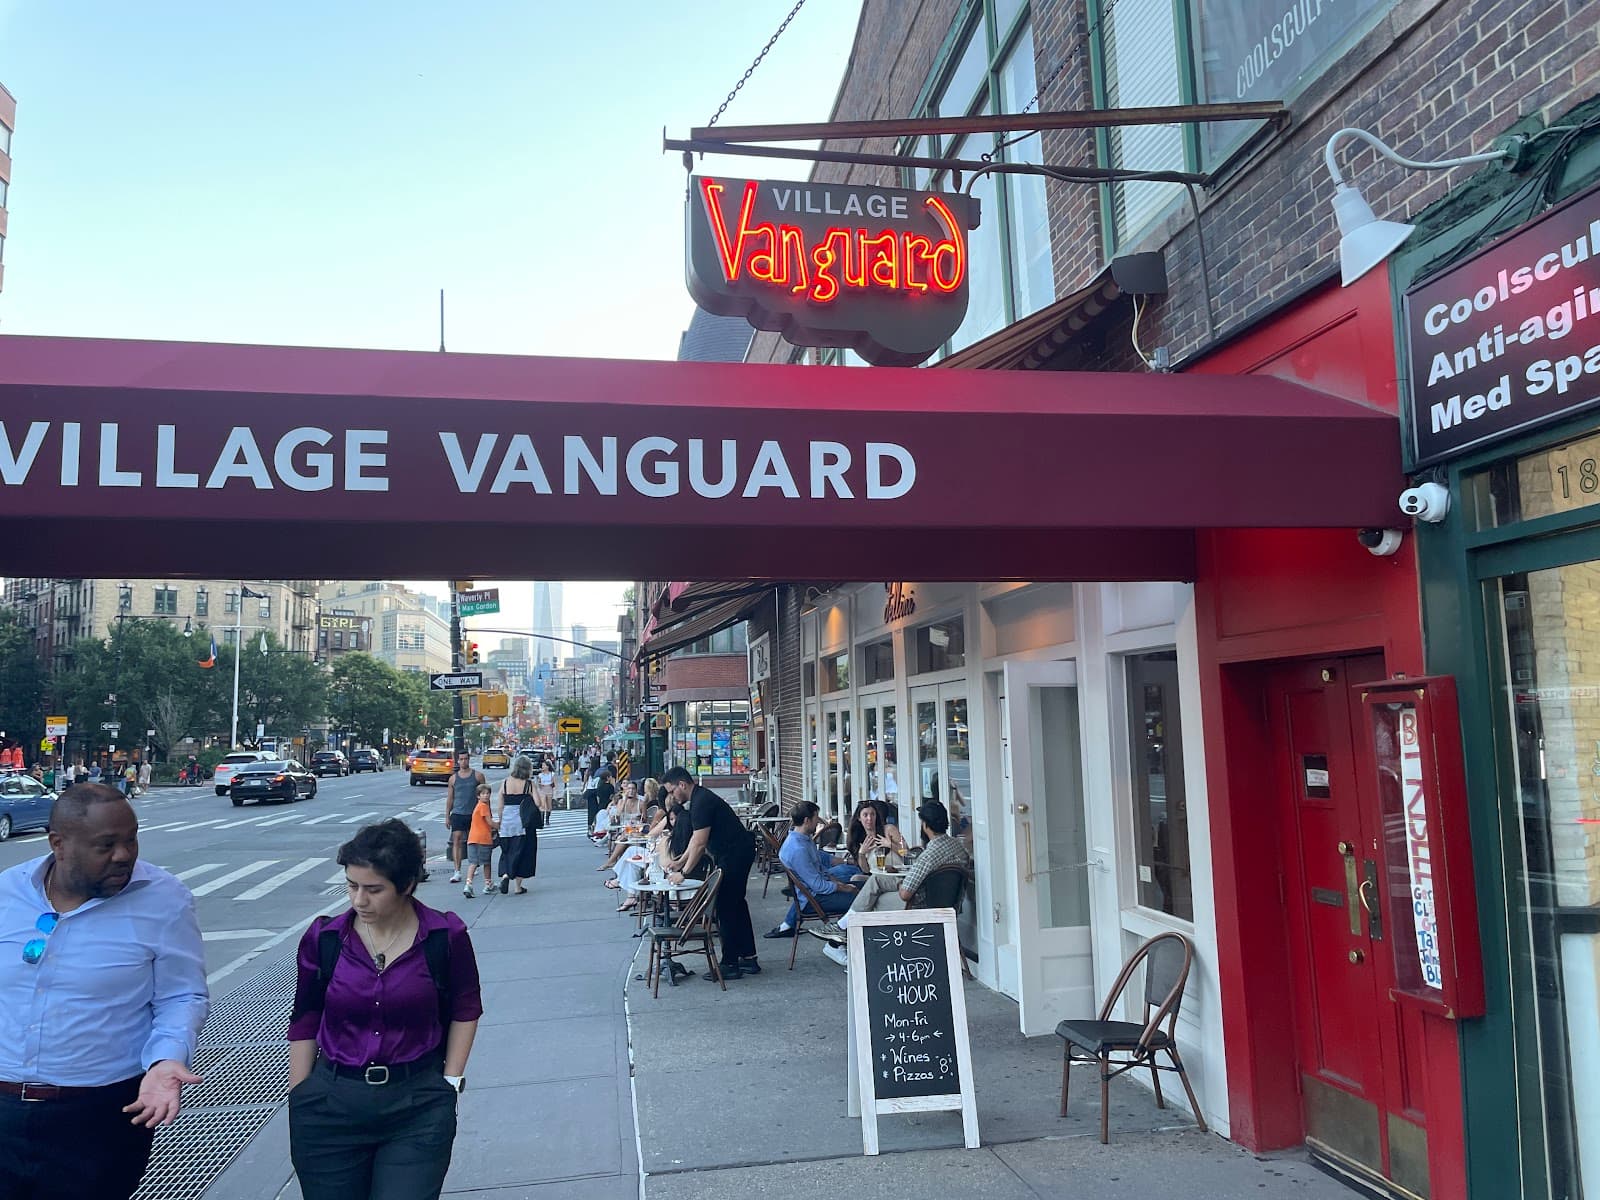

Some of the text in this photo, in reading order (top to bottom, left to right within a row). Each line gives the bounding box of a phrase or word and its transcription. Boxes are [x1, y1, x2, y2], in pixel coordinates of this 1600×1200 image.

[771, 187, 909, 219] VILLAGE
[699, 177, 965, 302] Vanguard
[1430, 344, 1600, 434] Med Spa
[0, 421, 917, 499] VILLAGE VANGUARD
[460, 592, 483, 603] Waverly
[475, 602, 497, 610] Gordon
[439, 676, 475, 687] ONE WAY
[887, 962, 934, 983] HAPPY
[897, 984, 938, 1004] HOUR
[890, 1046, 930, 1064] Wines
[893, 1066, 934, 1082] Pizzas
